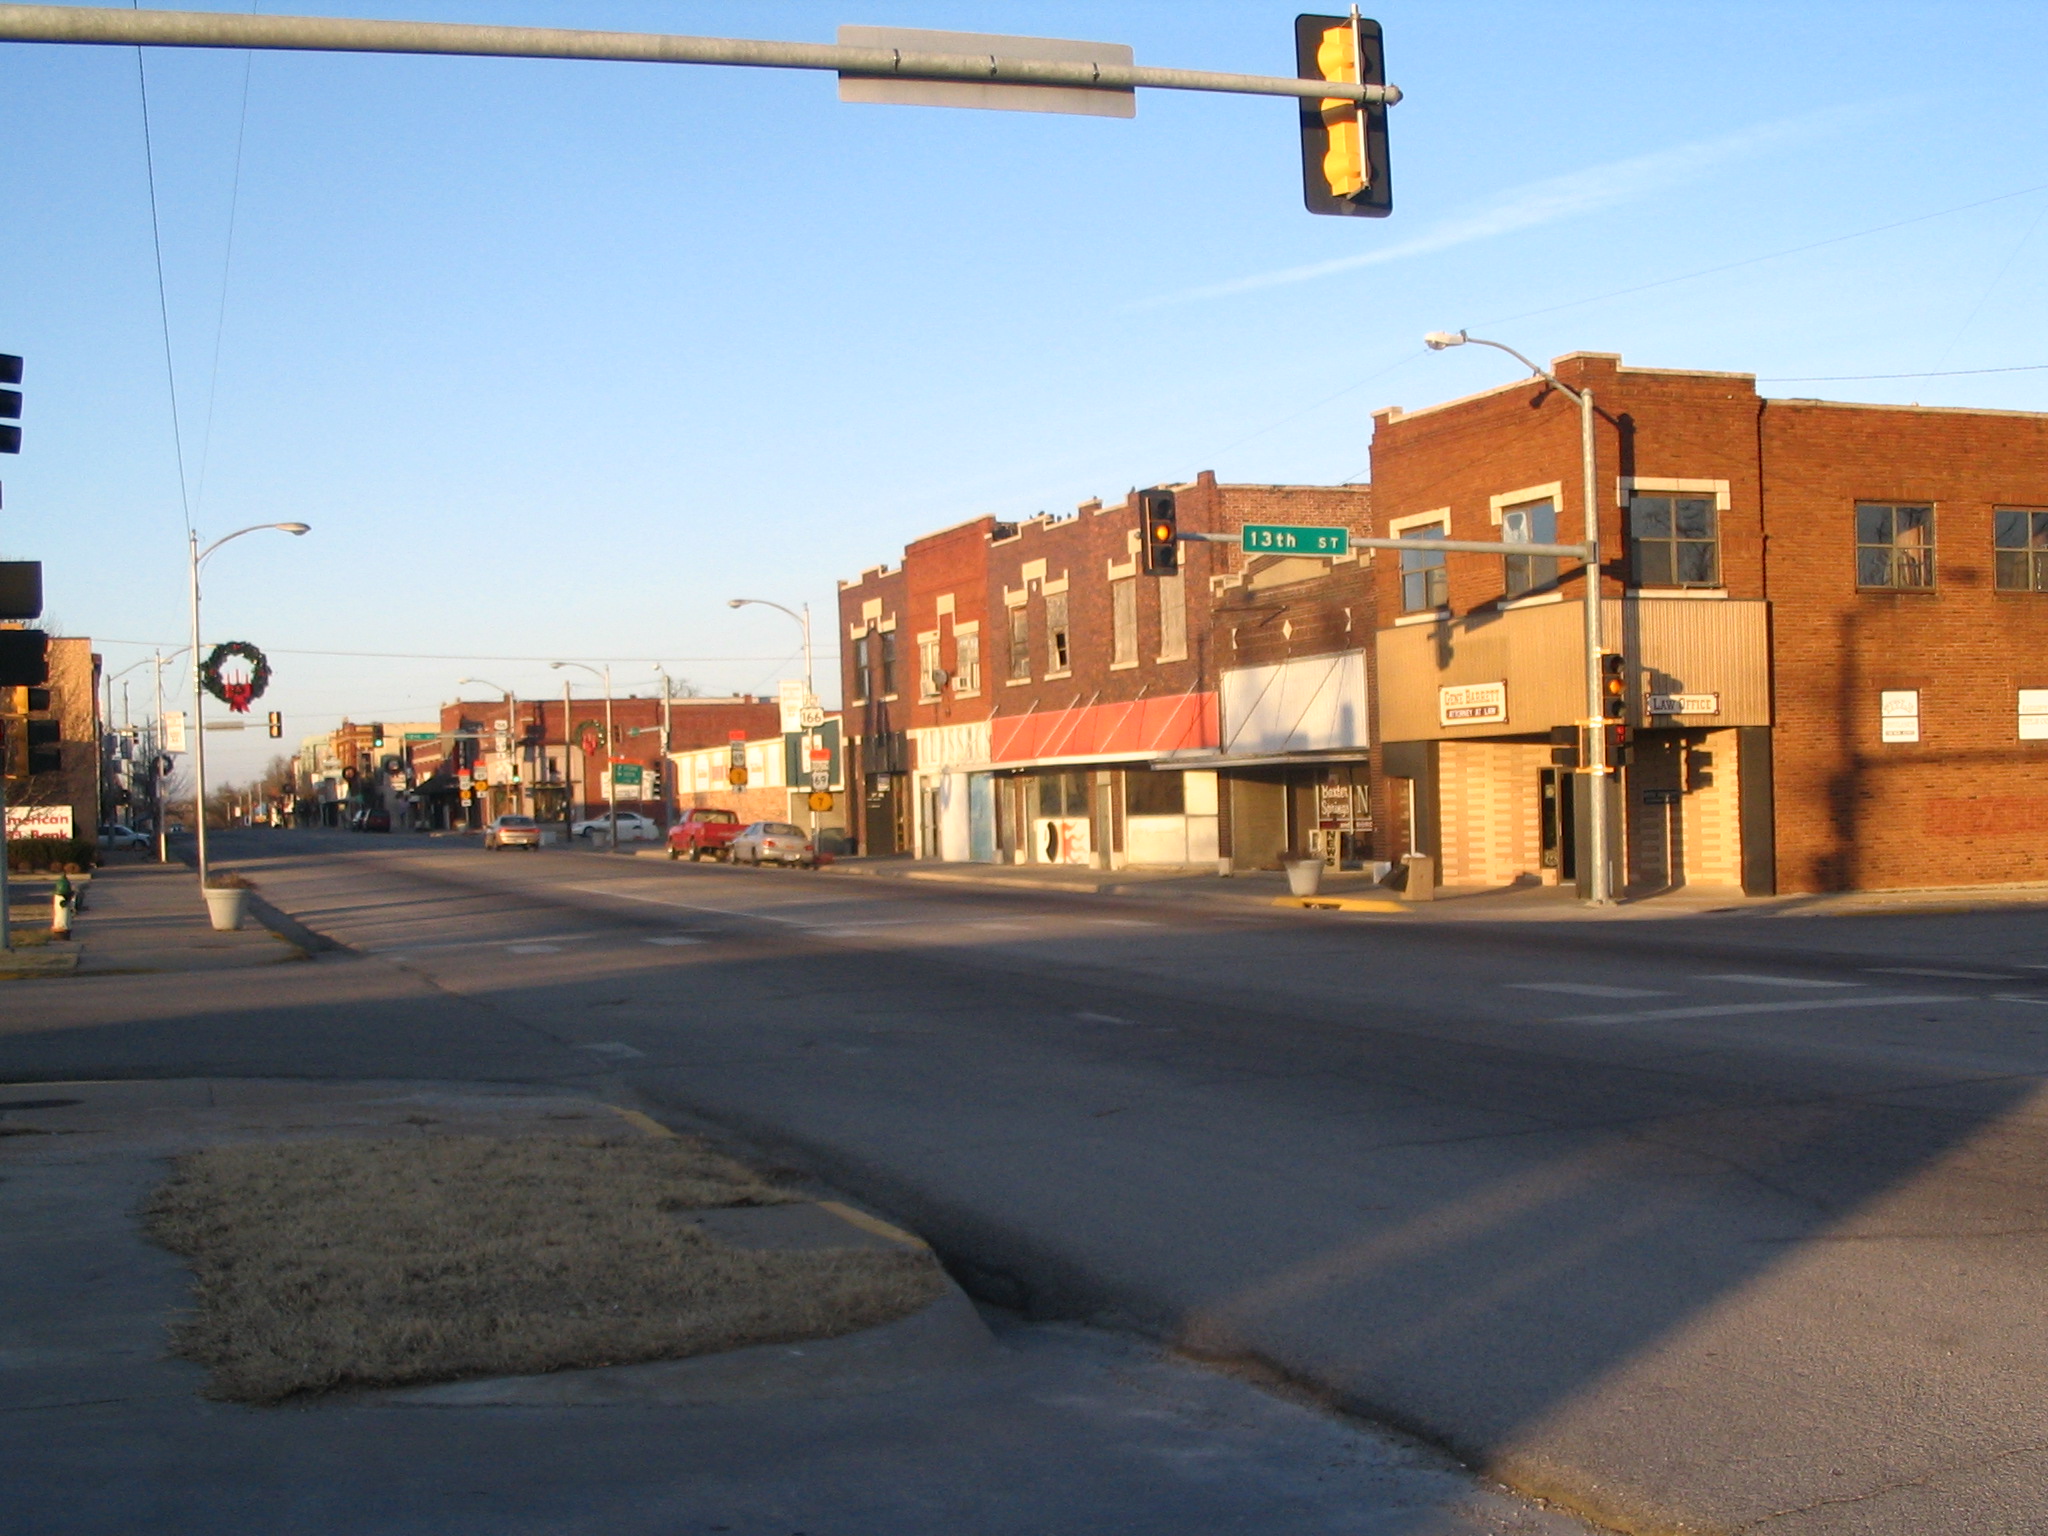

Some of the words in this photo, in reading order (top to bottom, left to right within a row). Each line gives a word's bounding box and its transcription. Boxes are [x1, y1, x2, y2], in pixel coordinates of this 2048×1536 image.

[1250, 530, 1297, 548] 13th
[1318, 537, 1340, 549] ST
[1653, 697, 1675, 711] LAW
[1679, 697, 1712, 710] OFFICE
[802, 712, 822, 723] 166
[814, 776, 827, 785] 69
[6, 815, 69, 825] merican
[1326, 831, 1336, 867] NEWS
